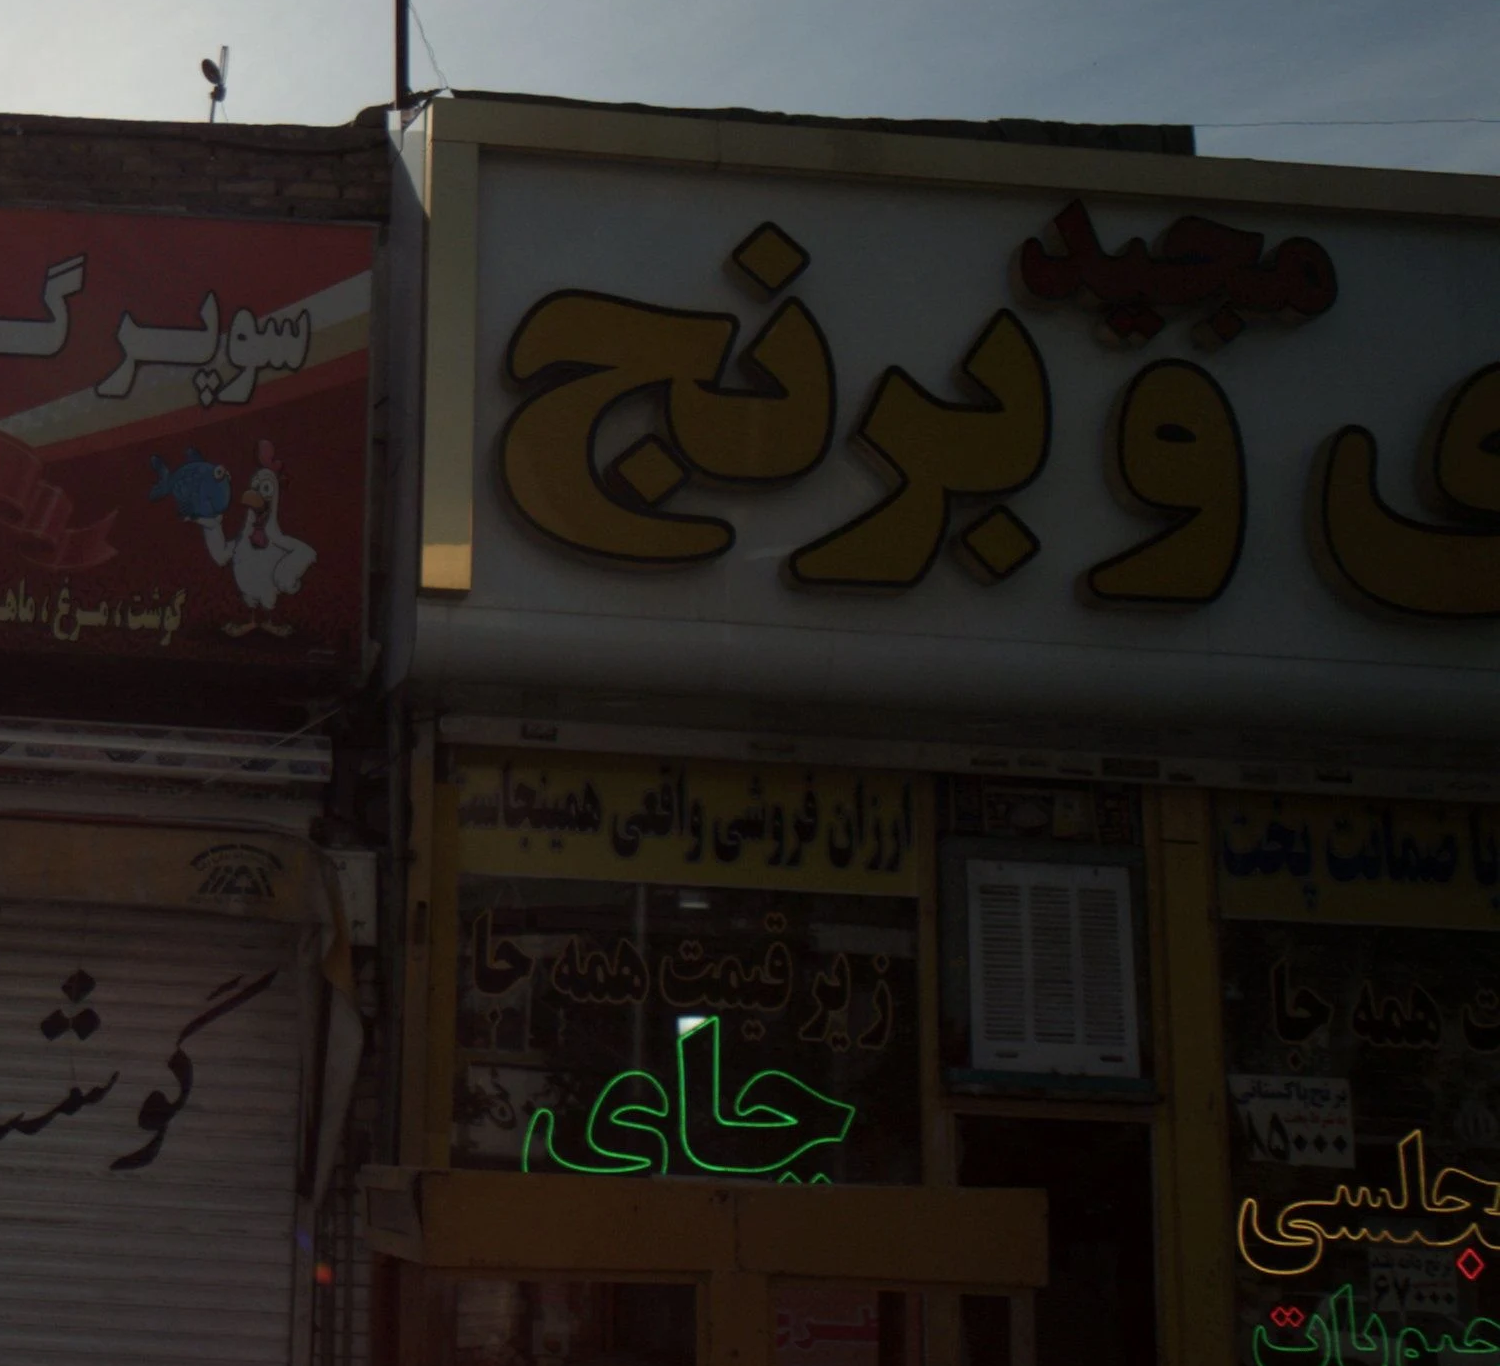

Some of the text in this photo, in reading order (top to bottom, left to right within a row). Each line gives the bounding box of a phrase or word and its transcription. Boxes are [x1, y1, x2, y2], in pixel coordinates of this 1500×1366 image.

[1014, 197, 1338, 349] مجید
[95, 289, 311, 409] سوپر
[498, 220, 1052, 591] برنج
[1083, 358, 1247, 605] و
[610, 760, 706, 863] واقعی
[713, 770, 820, 866] فروشی
[827, 776, 914, 872] ارزان
[471, 908, 893, 1052] زیر قیمت همه جا
[1269, 957, 1335, 1072] جا
[1350, 980, 1442, 1050] همه
[1237, 1126, 1500, 1276] جلسی
